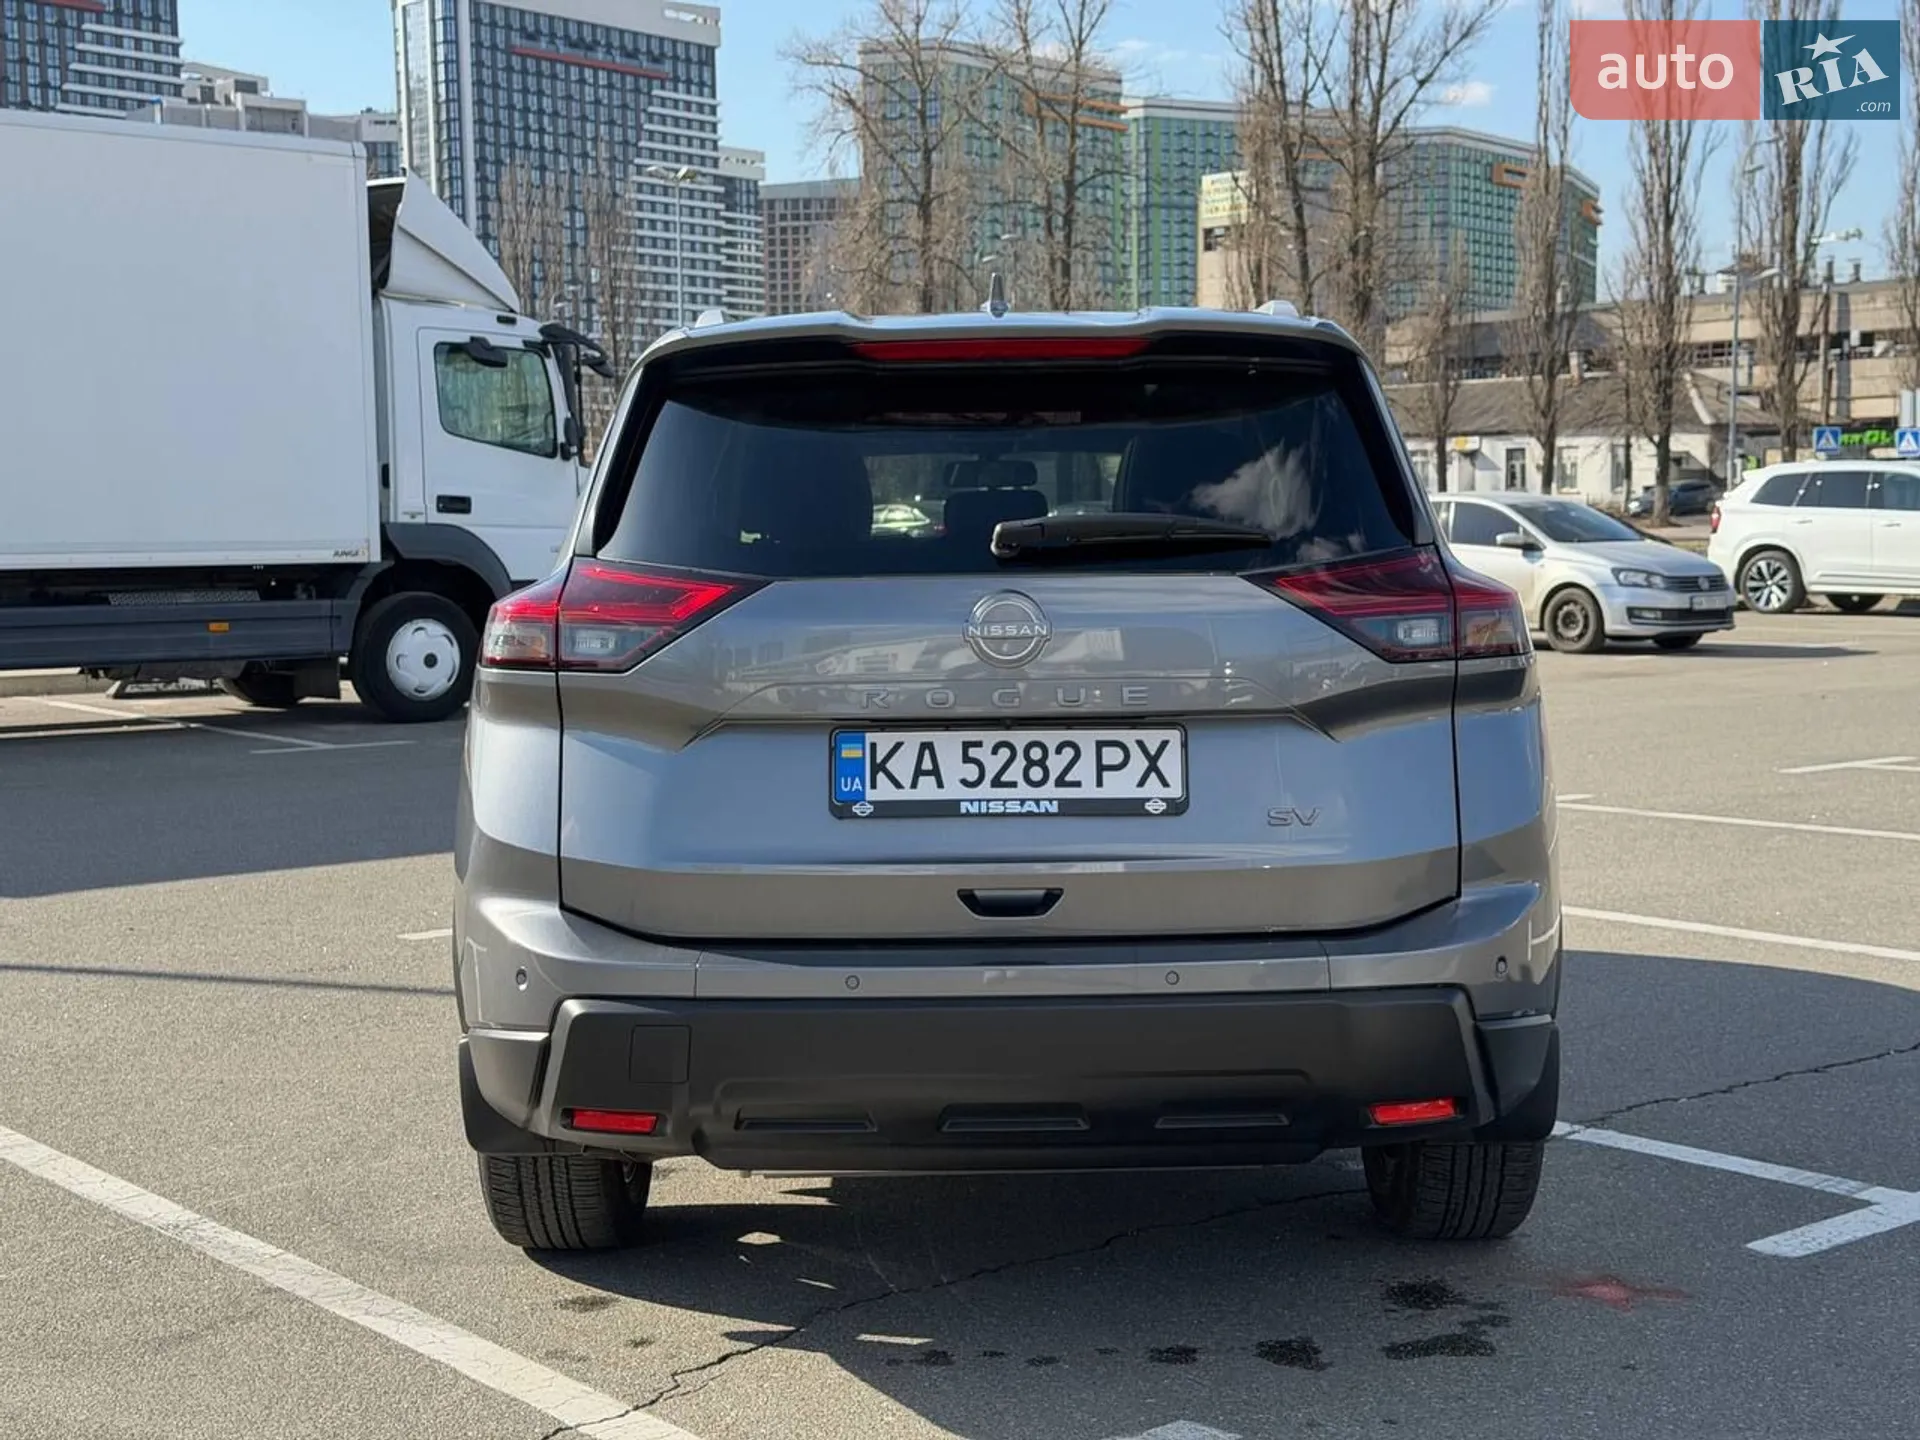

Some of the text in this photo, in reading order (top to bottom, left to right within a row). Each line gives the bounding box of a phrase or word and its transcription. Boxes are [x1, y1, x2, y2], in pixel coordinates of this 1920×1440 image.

[968, 624, 1047, 637] NISSAN
[861, 686, 1149, 709] ROGUE
[869, 739, 1171, 790] KA 5282 PX
[841, 777, 863, 792] UA
[960, 800, 1059, 814] NISSAN
[1267, 806, 1321, 827] SV
